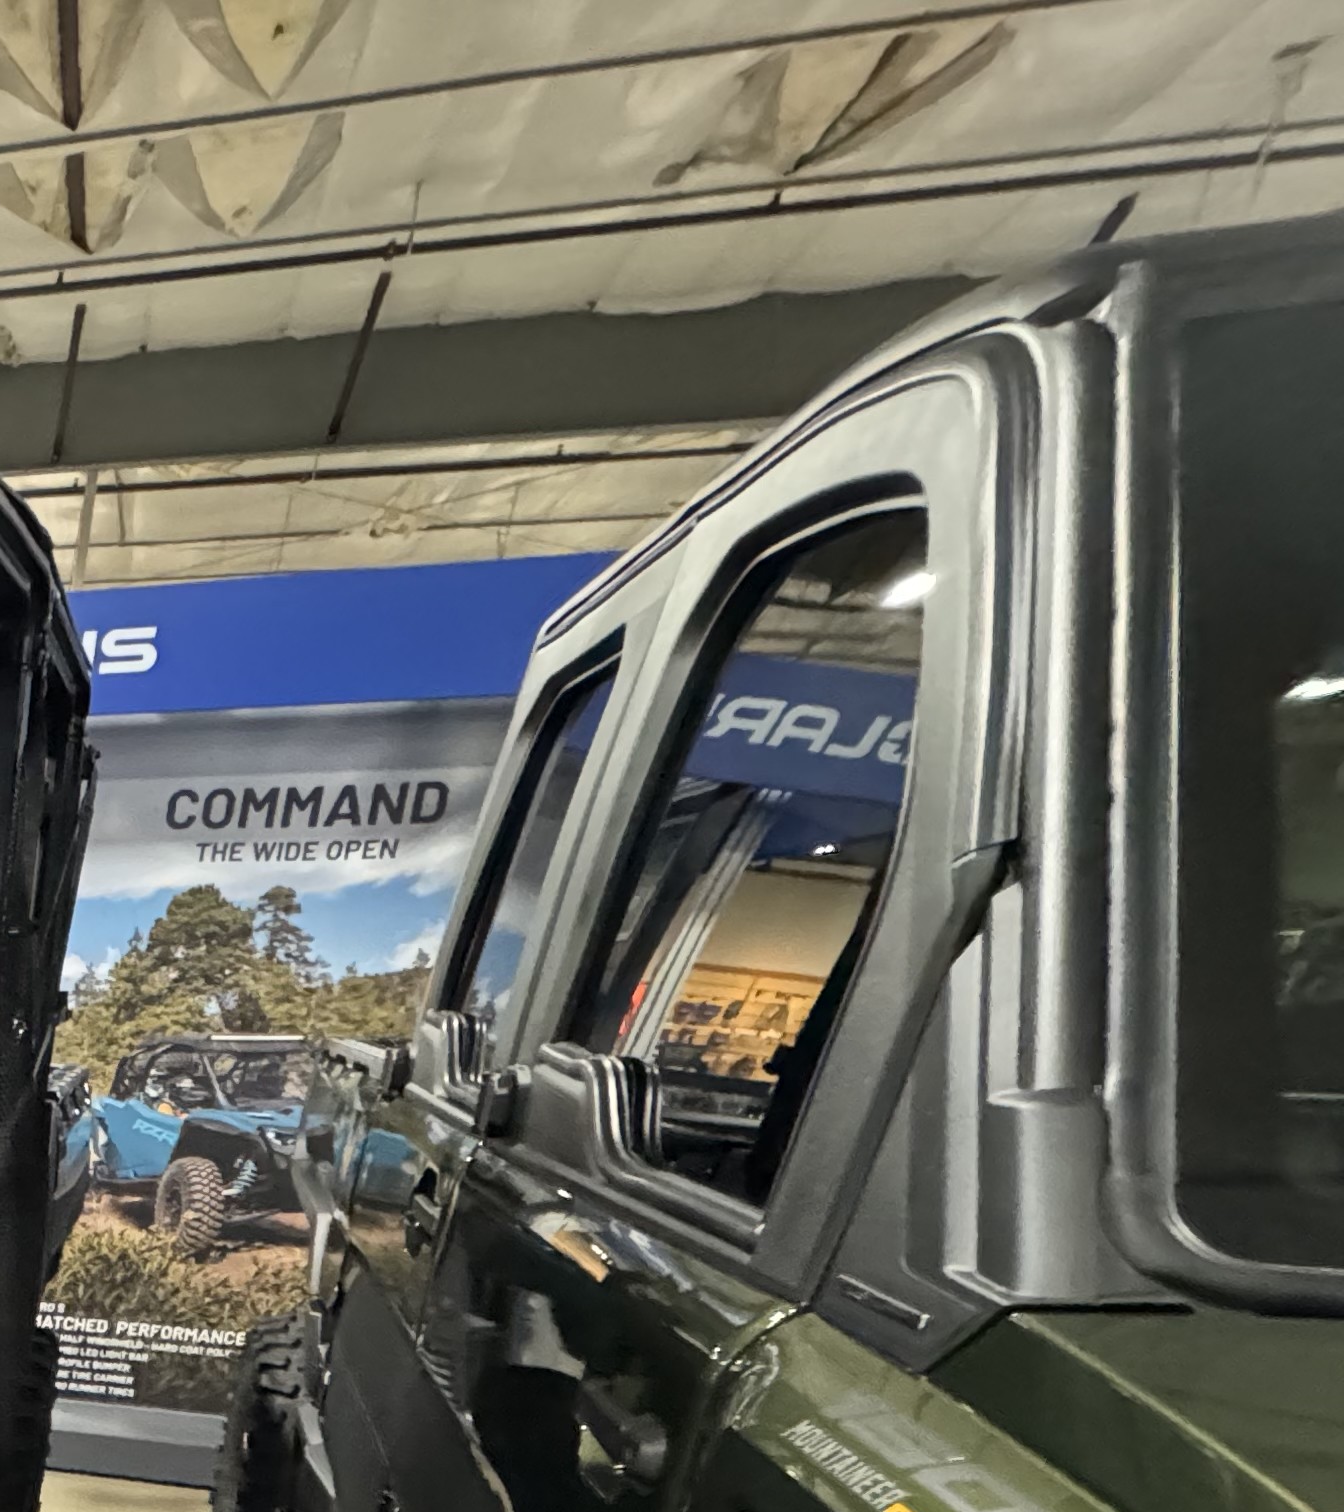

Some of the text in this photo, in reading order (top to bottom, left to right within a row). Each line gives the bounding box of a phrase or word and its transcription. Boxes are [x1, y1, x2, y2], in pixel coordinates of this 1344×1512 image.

[165, 780, 450, 830] COMMAND
[195, 838, 400, 862] THE WIDE OPEN
[115, 1319, 247, 1347] PERFORMANCE
[779, 1418, 914, 1512] MOUNTAINEER
